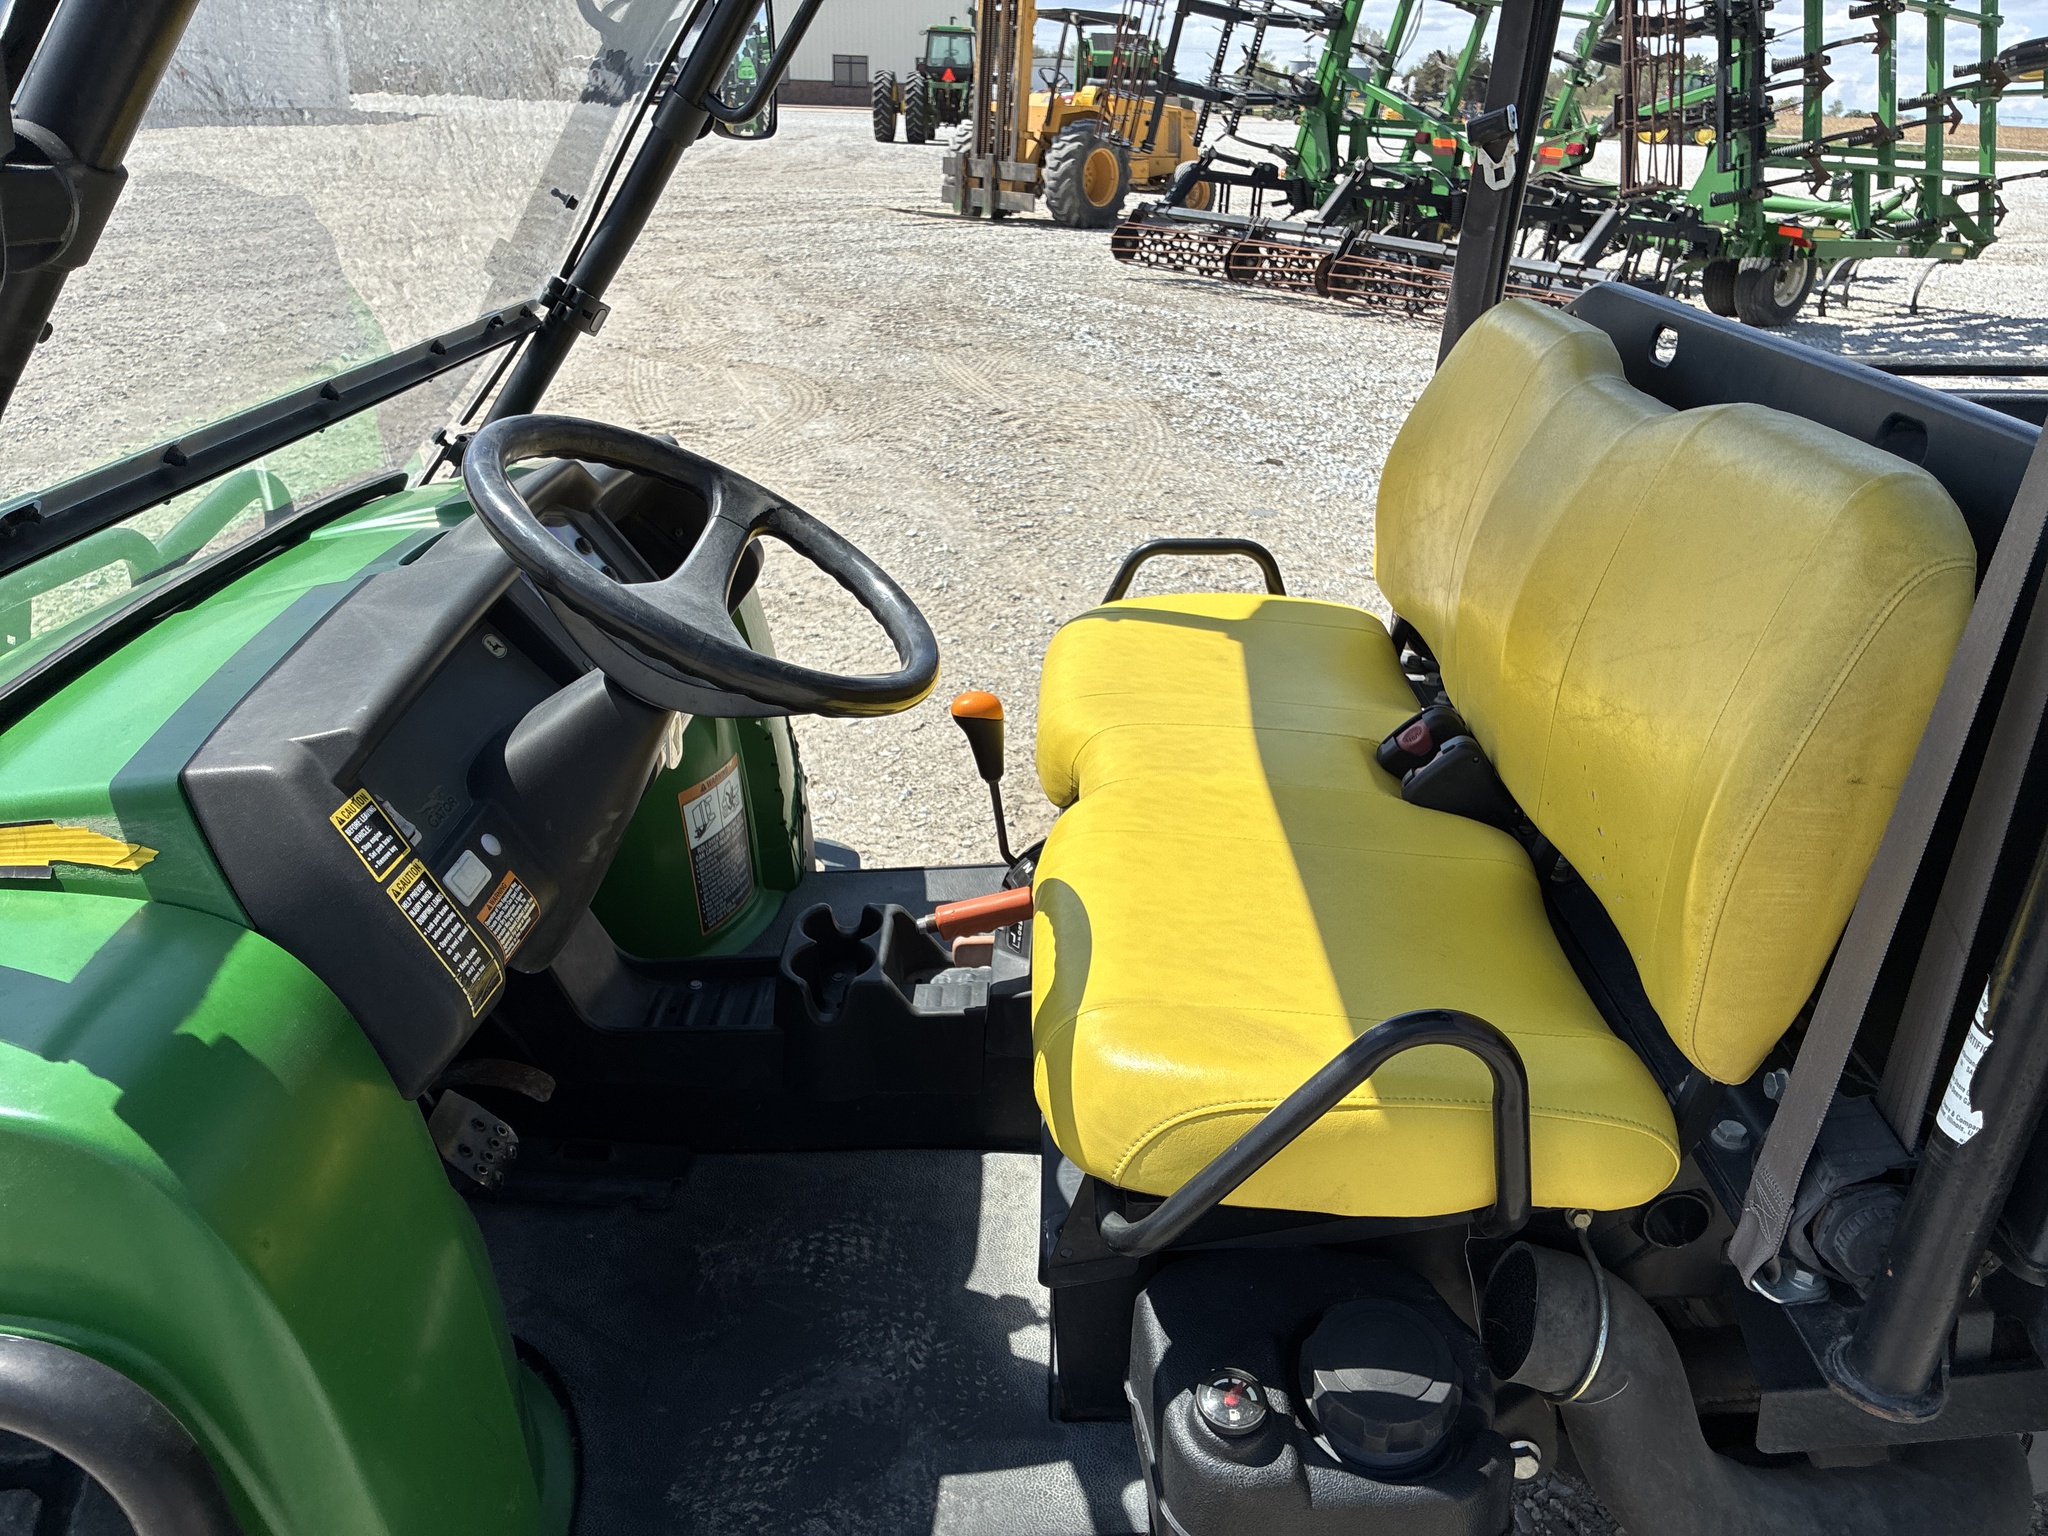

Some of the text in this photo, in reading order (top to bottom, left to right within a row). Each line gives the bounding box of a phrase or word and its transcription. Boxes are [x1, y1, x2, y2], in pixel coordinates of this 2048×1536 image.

[340, 792, 369, 819] CAUTION
[425, 795, 458, 829] GATOR
[344, 804, 376, 836] BEFORE LEAVING
[352, 824, 372, 844] VEHICLE:
[360, 830, 383, 851] Stop engine
[368, 834, 393, 858] Set park brake
[376, 850, 391, 866] Remove
[388, 844, 398, 853] key
[395, 862, 422, 891] CAUTION
[400, 880, 427, 910] HELP PREVENT
[408, 889, 433, 918] INJURY WHEN
[489, 882, 507, 906] WARNING
[416, 892, 444, 925] DUMPING LOADS
[424, 904, 449, 933] Lock park brake
[432, 911, 457, 940] before dumping
[439, 921, 462, 948] Operate dump
[448, 939, 459, 950] level
[456, 926, 469, 941] ground
[451, 951, 462, 962] only
[458, 947, 477, 969] Keep hands
[465, 956, 481, 977] away from
